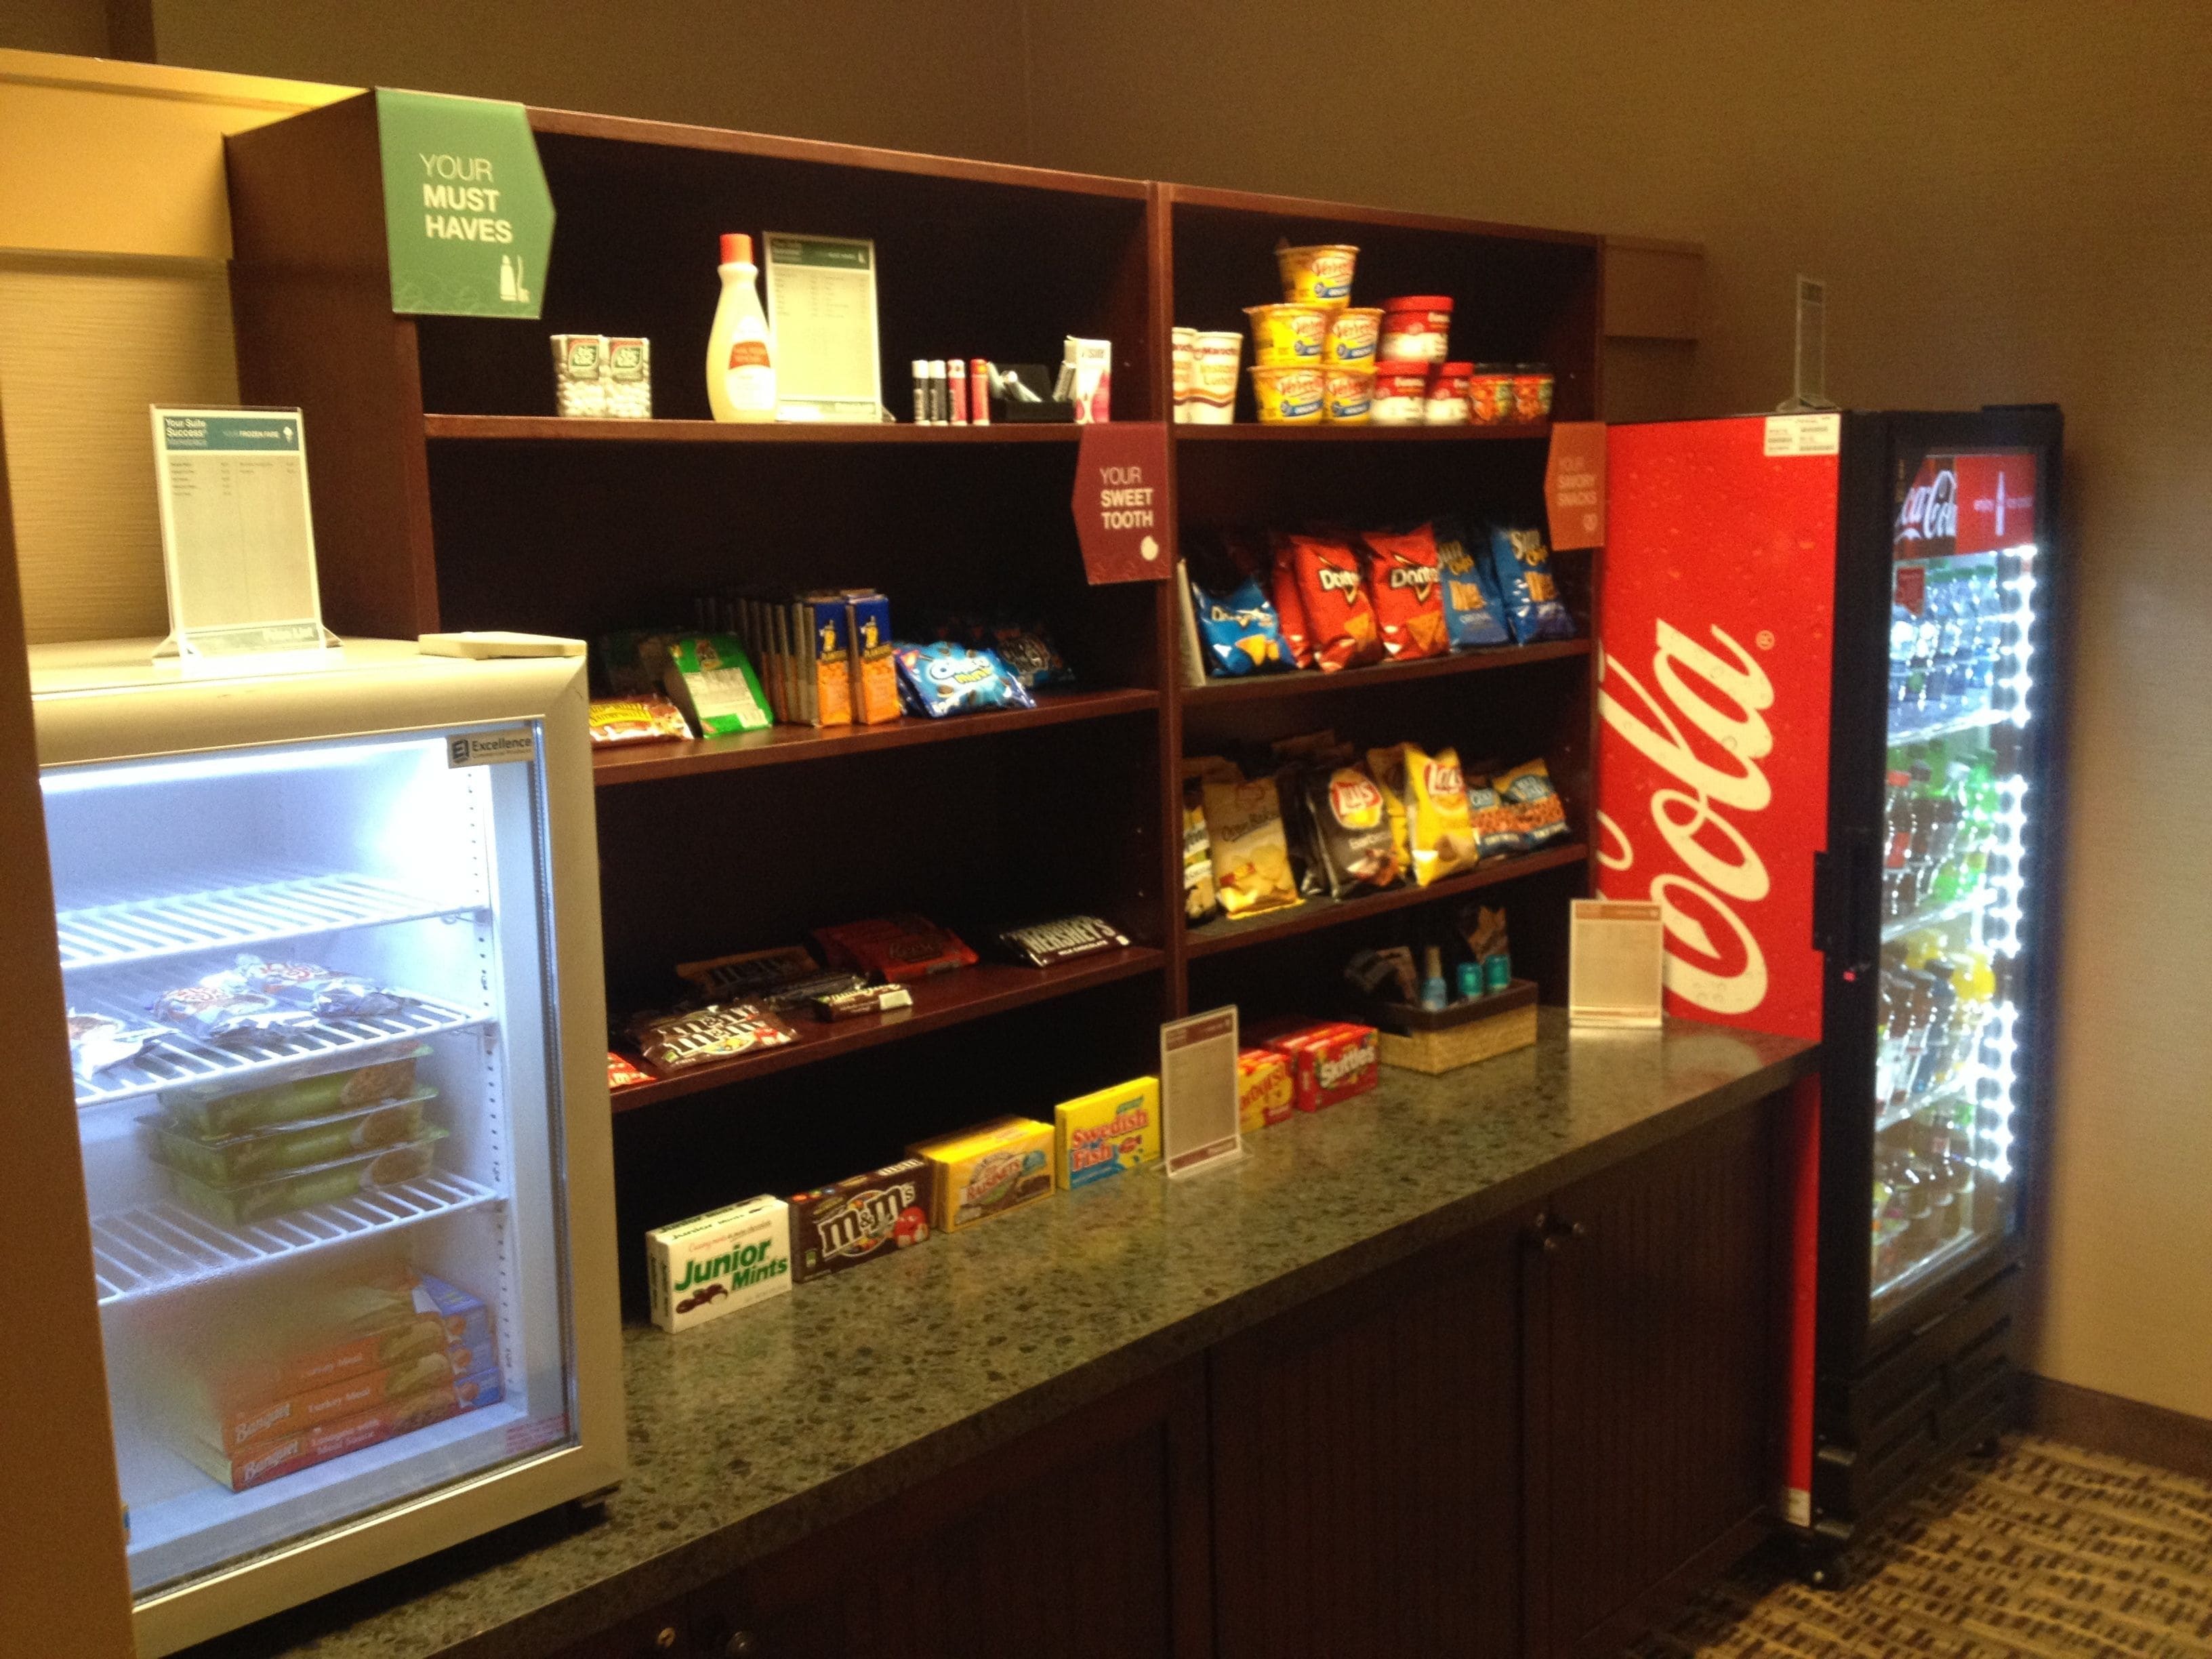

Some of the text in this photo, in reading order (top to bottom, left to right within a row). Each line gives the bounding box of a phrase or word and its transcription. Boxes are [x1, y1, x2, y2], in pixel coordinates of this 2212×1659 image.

[419, 152, 494, 182] YOUR
[422, 183, 501, 213] MUST
[424, 214, 514, 244] HAVES
[1099, 466, 1142, 485] YOUR
[1100, 488, 1154, 508] SWEET
[1101, 510, 1153, 529] TOOTH
[472, 738, 532, 752] Excellence
[1598, 617, 1775, 1015] Cola
[1072, 1108, 1149, 1149] Swedish
[1072, 1142, 1114, 1172] Fish
[674, 1236, 773, 1292] Junior
[731, 1257, 787, 1292] Mints
